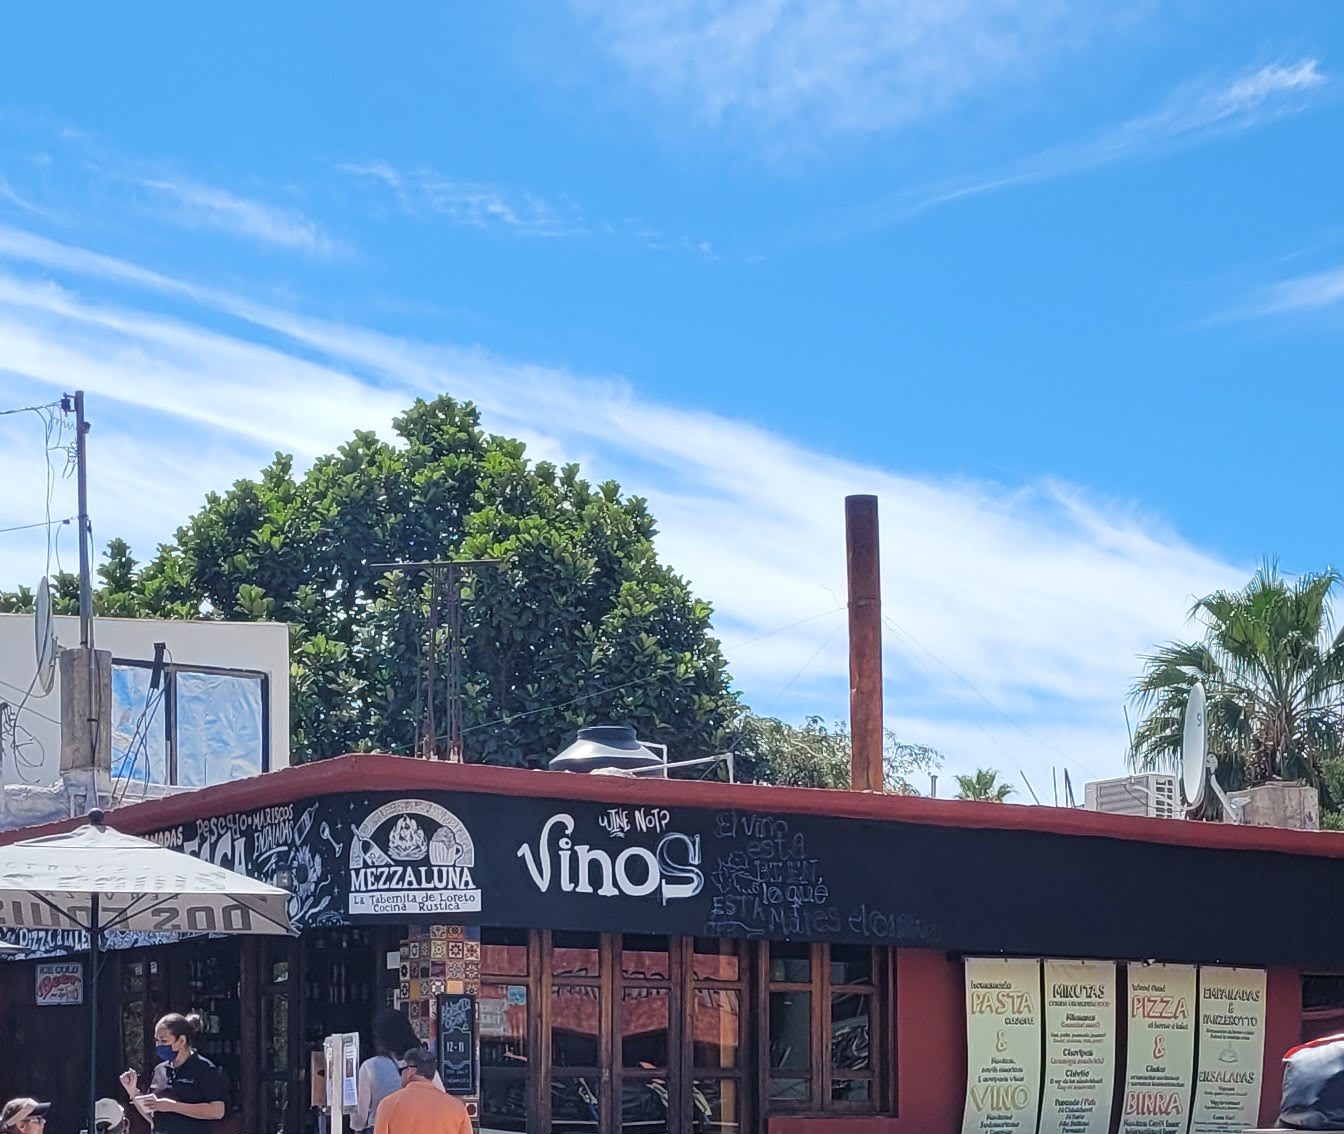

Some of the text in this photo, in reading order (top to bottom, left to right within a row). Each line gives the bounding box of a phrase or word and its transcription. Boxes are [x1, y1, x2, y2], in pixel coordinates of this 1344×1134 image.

[253, 804, 294, 829] MARISCOS
[253, 821, 294, 859] ENSALADAS
[350, 866, 477, 892] MEZZALUNA
[353, 896, 365, 905] La
[421, 892, 436, 903] de
[439, 893, 476, 903] Loreto
[373, 901, 461, 912] Cocina Rustica
[971, 990, 1035, 1015] PASTA
[1052, 983, 1106, 1000] MINUTAS
[1131, 994, 1190, 1020] PIZZA
[995, 1029, 1009, 1054] &
[1152, 1034, 1167, 1060] &
[971, 1084, 1030, 1113] VINO
[1124, 1090, 1185, 1117] BIRRA
